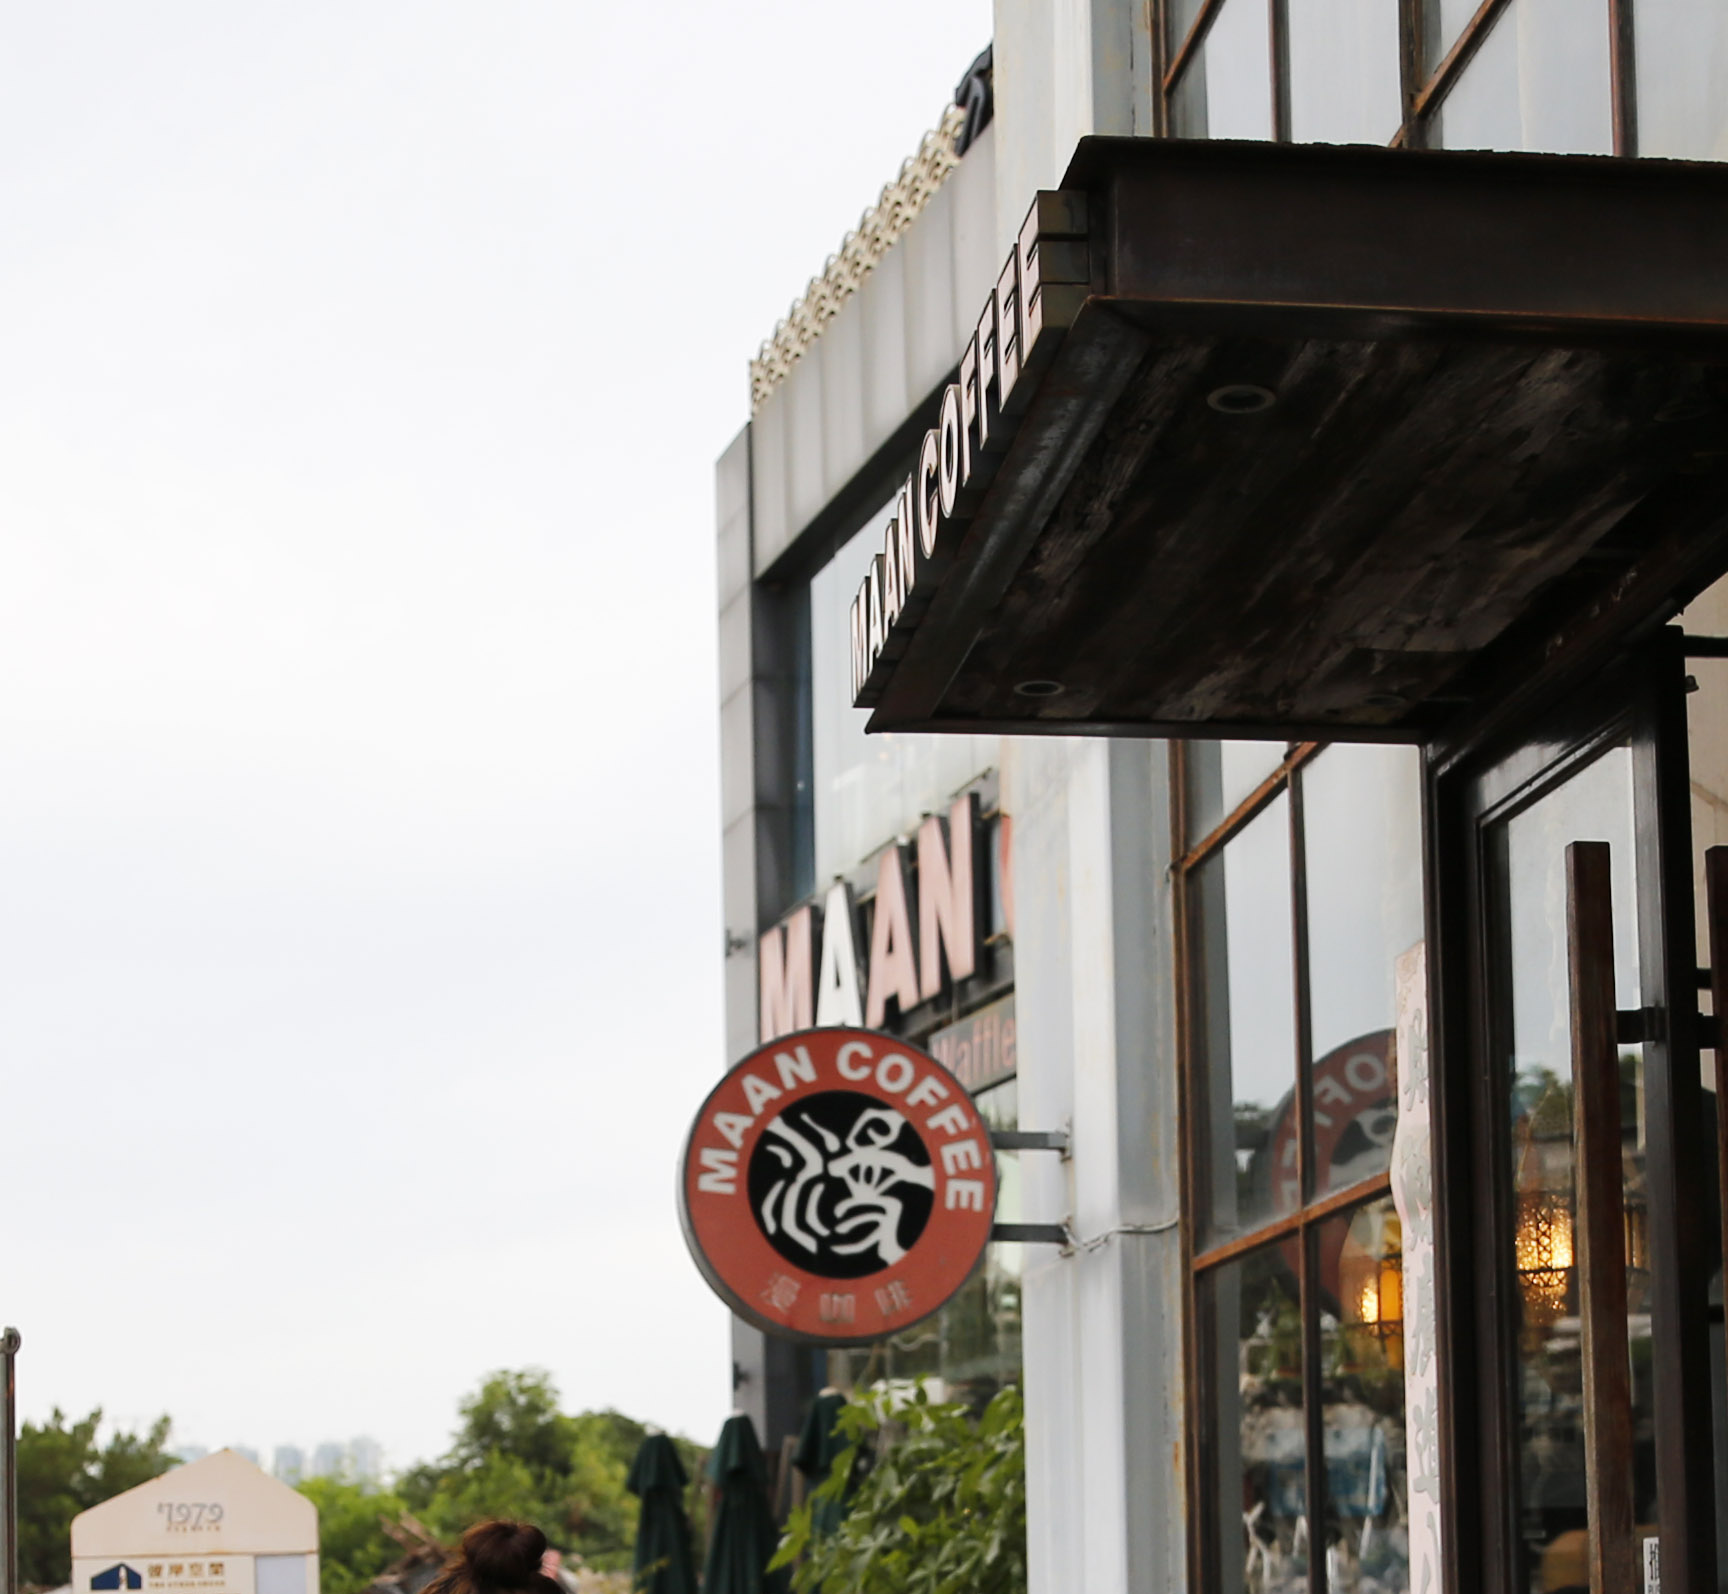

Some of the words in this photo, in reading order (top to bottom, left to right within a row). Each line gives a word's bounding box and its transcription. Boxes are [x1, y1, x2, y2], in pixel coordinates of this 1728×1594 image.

[849, 473, 915, 707] MAAN
[917, 190, 1046, 561] COFFEE
[759, 793, 974, 1046] MAAN
[697, 1046, 819, 1196] MAAN
[836, 1040, 985, 1213] COFFEE
